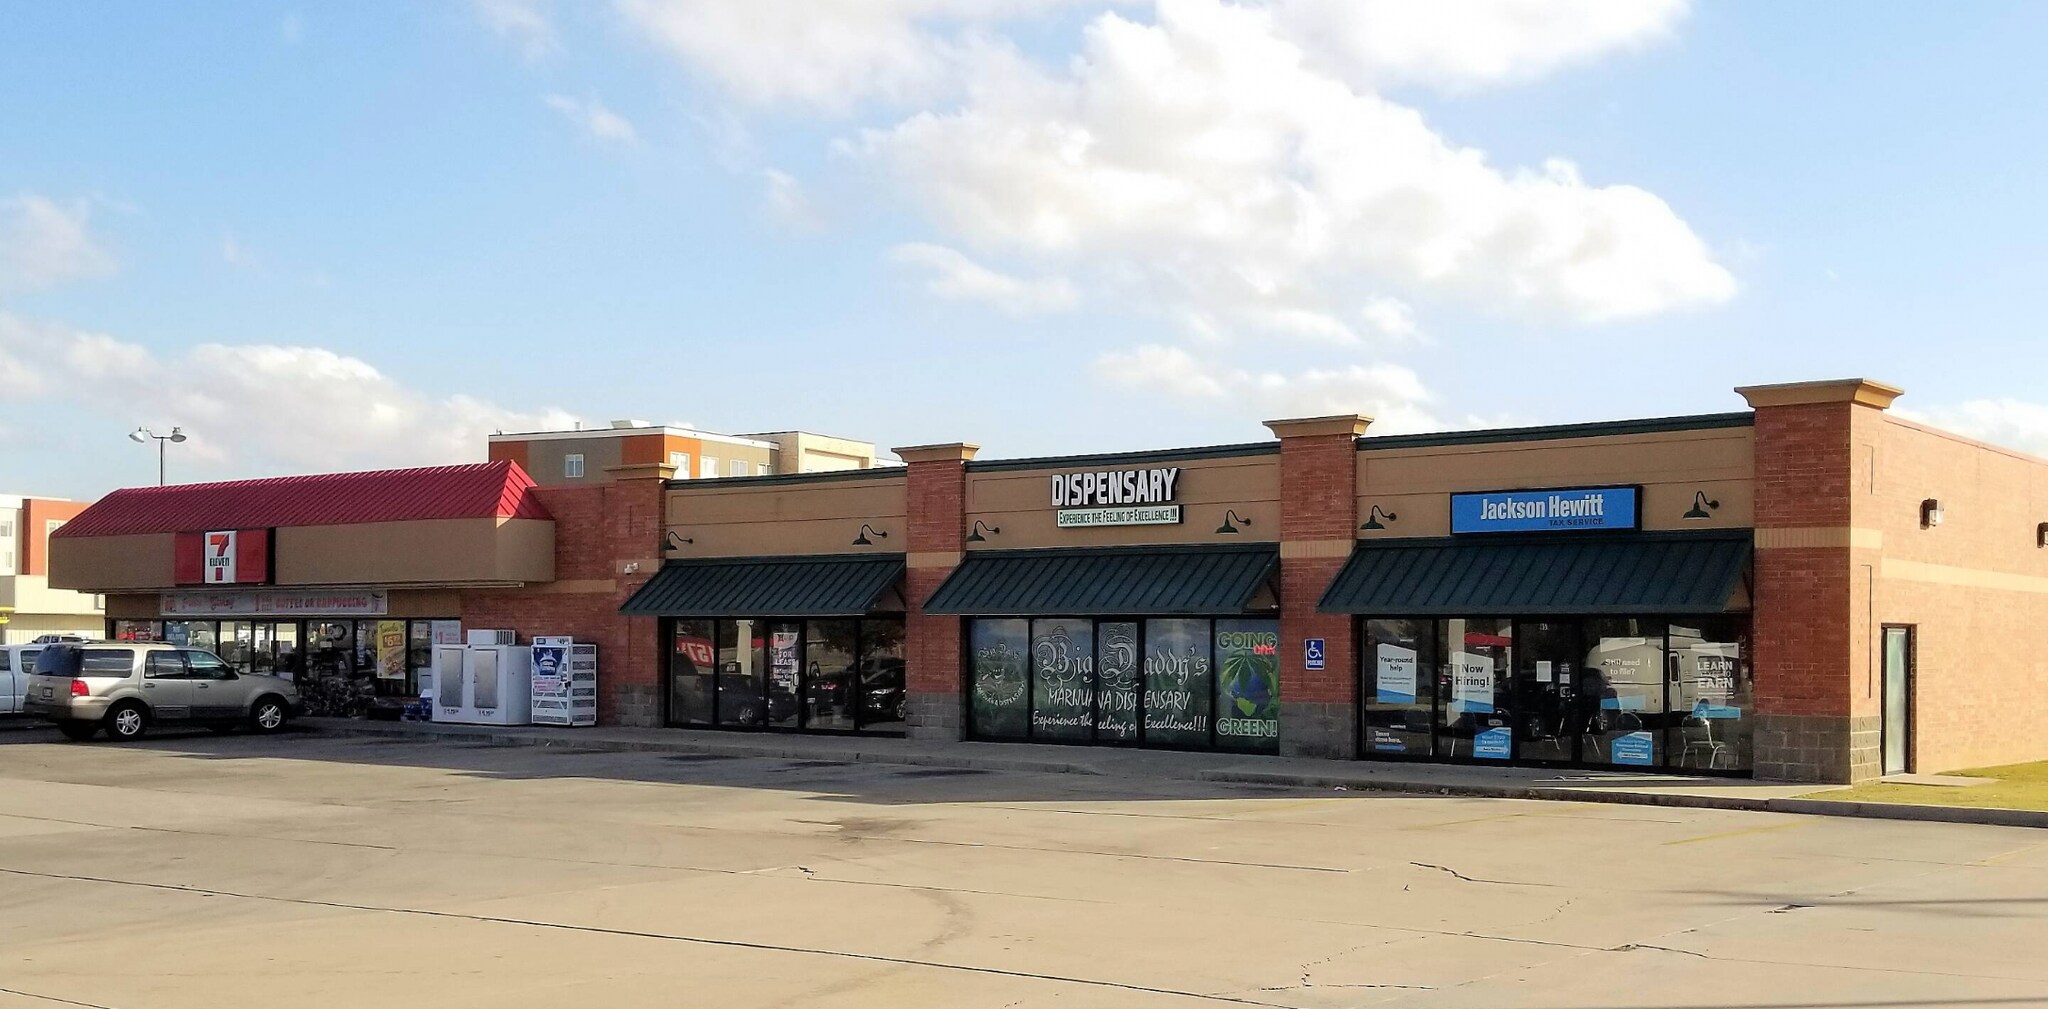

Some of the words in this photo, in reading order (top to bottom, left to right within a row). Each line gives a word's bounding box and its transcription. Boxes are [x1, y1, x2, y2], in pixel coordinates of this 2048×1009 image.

[1052, 467, 1178, 506] DISPENSARY
[1480, 497, 1545, 520] Jackson
[1549, 494, 1604, 517] Hewitt
[1550, 519, 1564, 527] TAX
[1567, 518, 1604, 526] SERVICE
[209, 558, 230, 567] ELEVEN
[1216, 631, 1278, 650] GOING
[1389, 664, 1403, 672] help
[1462, 664, 1484, 673] Now
[1697, 661, 1733, 670] LEARN
[1455, 676, 1490, 688] Hiring!
[1697, 677, 1733, 688] EARN
[1032, 710, 1078, 731] Experience
[1097, 715, 1126, 737] eeling
[1216, 717, 1278, 738] GREEN!
